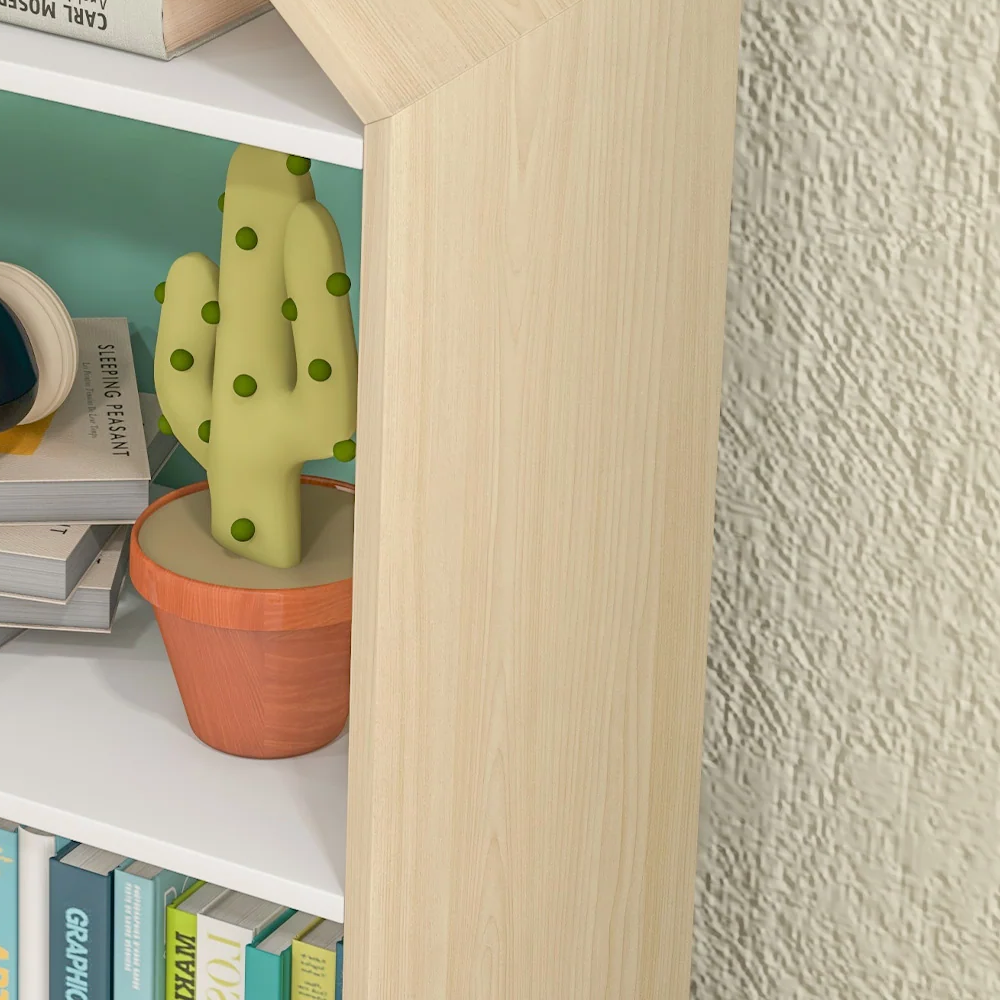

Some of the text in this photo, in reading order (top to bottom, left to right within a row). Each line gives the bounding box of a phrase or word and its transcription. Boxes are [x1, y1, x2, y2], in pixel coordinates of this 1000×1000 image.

[63, 4, 108, 31] CARL
[98, 344, 130, 456] SLEEPING PEASANT
